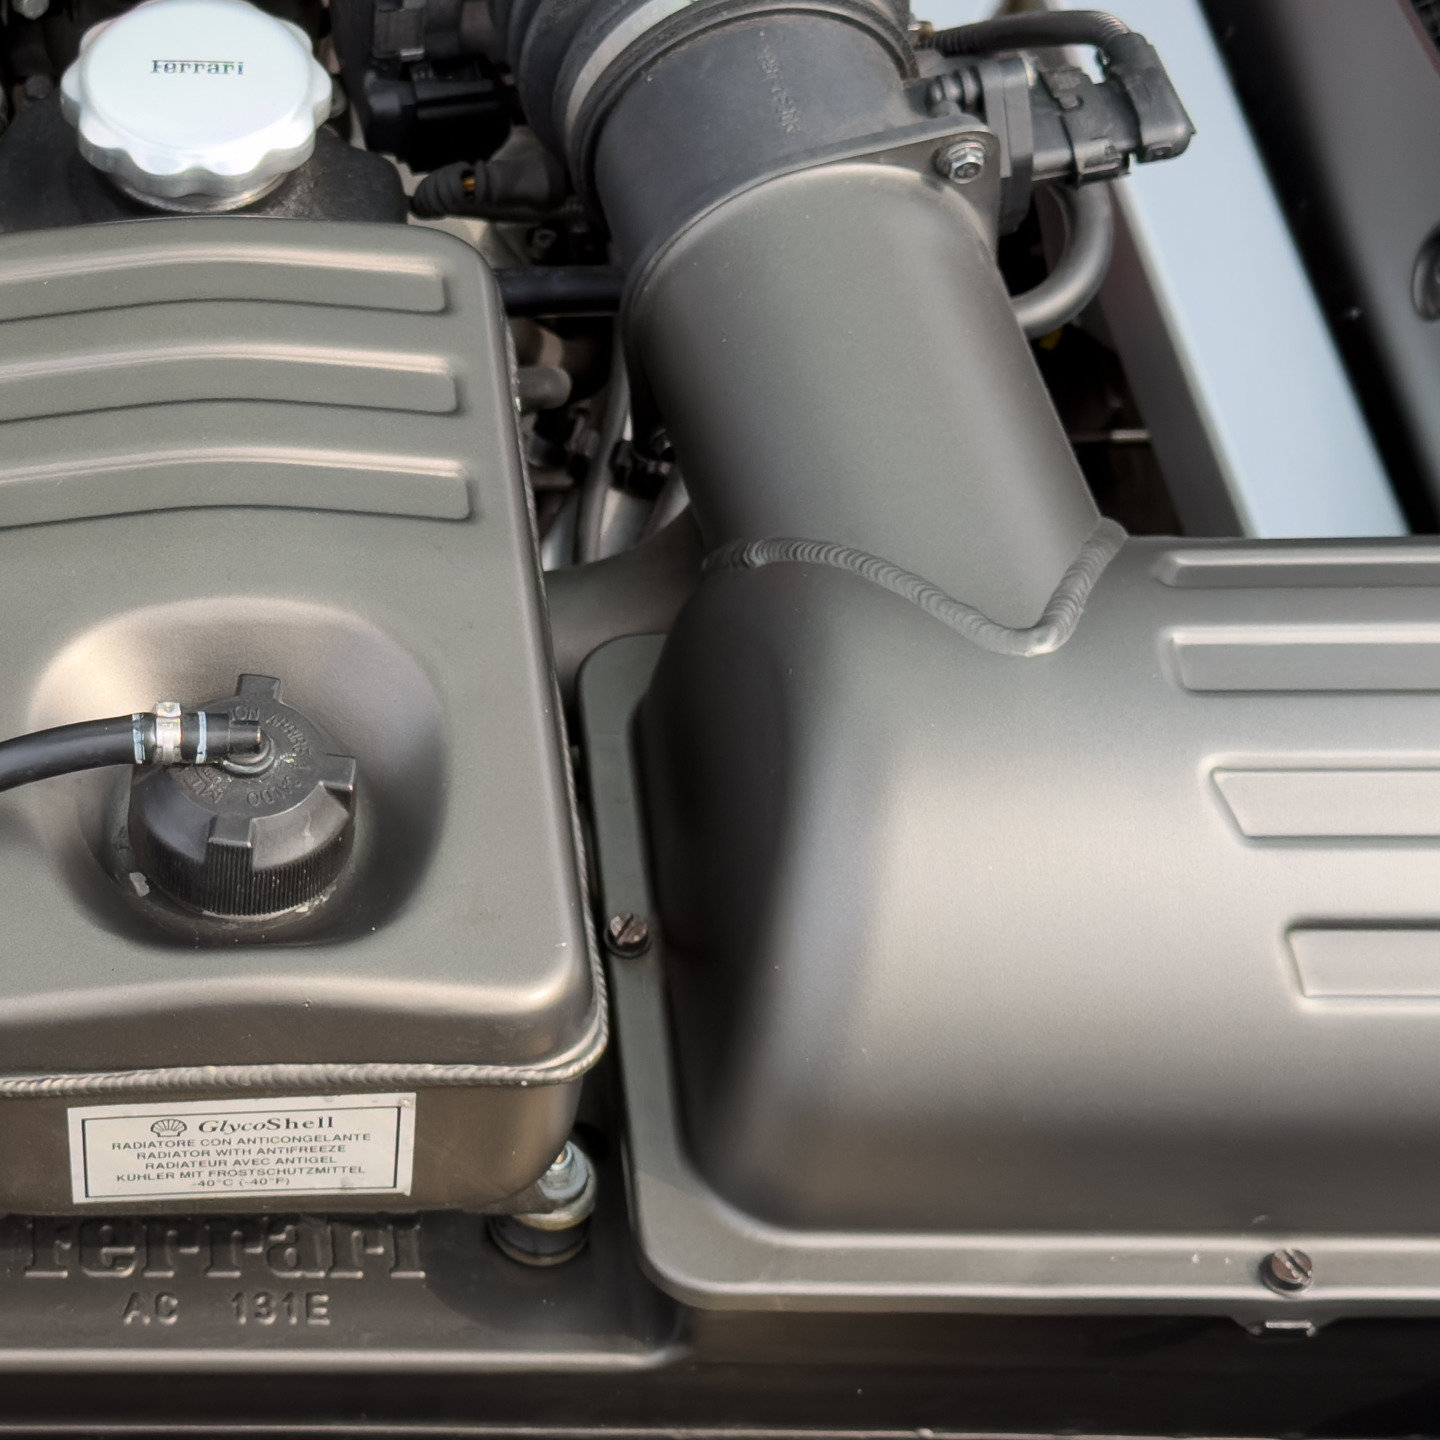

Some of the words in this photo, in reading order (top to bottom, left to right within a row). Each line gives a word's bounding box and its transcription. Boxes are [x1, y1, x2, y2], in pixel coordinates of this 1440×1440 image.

[150, 59, 244, 76] Ferrari
[198, 1116, 334, 1135] GlycoShell
[111, 1139, 195, 1150] RADIATORE
[200, 1137, 232, 1147] CON
[237, 1132, 371, 1145] ANTICONGELANTE
[136, 1149, 211, 1160] RADIATOR
[215, 1148, 252, 1157] WITH
[256, 1144, 346, 1155] ANTIFREEZE
[145, 1159, 228, 1170] RADIATEUR
[233, 1157, 270, 1166] AVEC
[275, 1155, 337, 1165] ANTIGEL
[179, 1170, 204, 1180] MIT
[208, 1165, 366, 1178] FROSTSCHUTZMITTEL
[23, 1215, 426, 1279] Ferrari
[122, 1291, 179, 1327] AC
[230, 1291, 331, 1327] 131E
